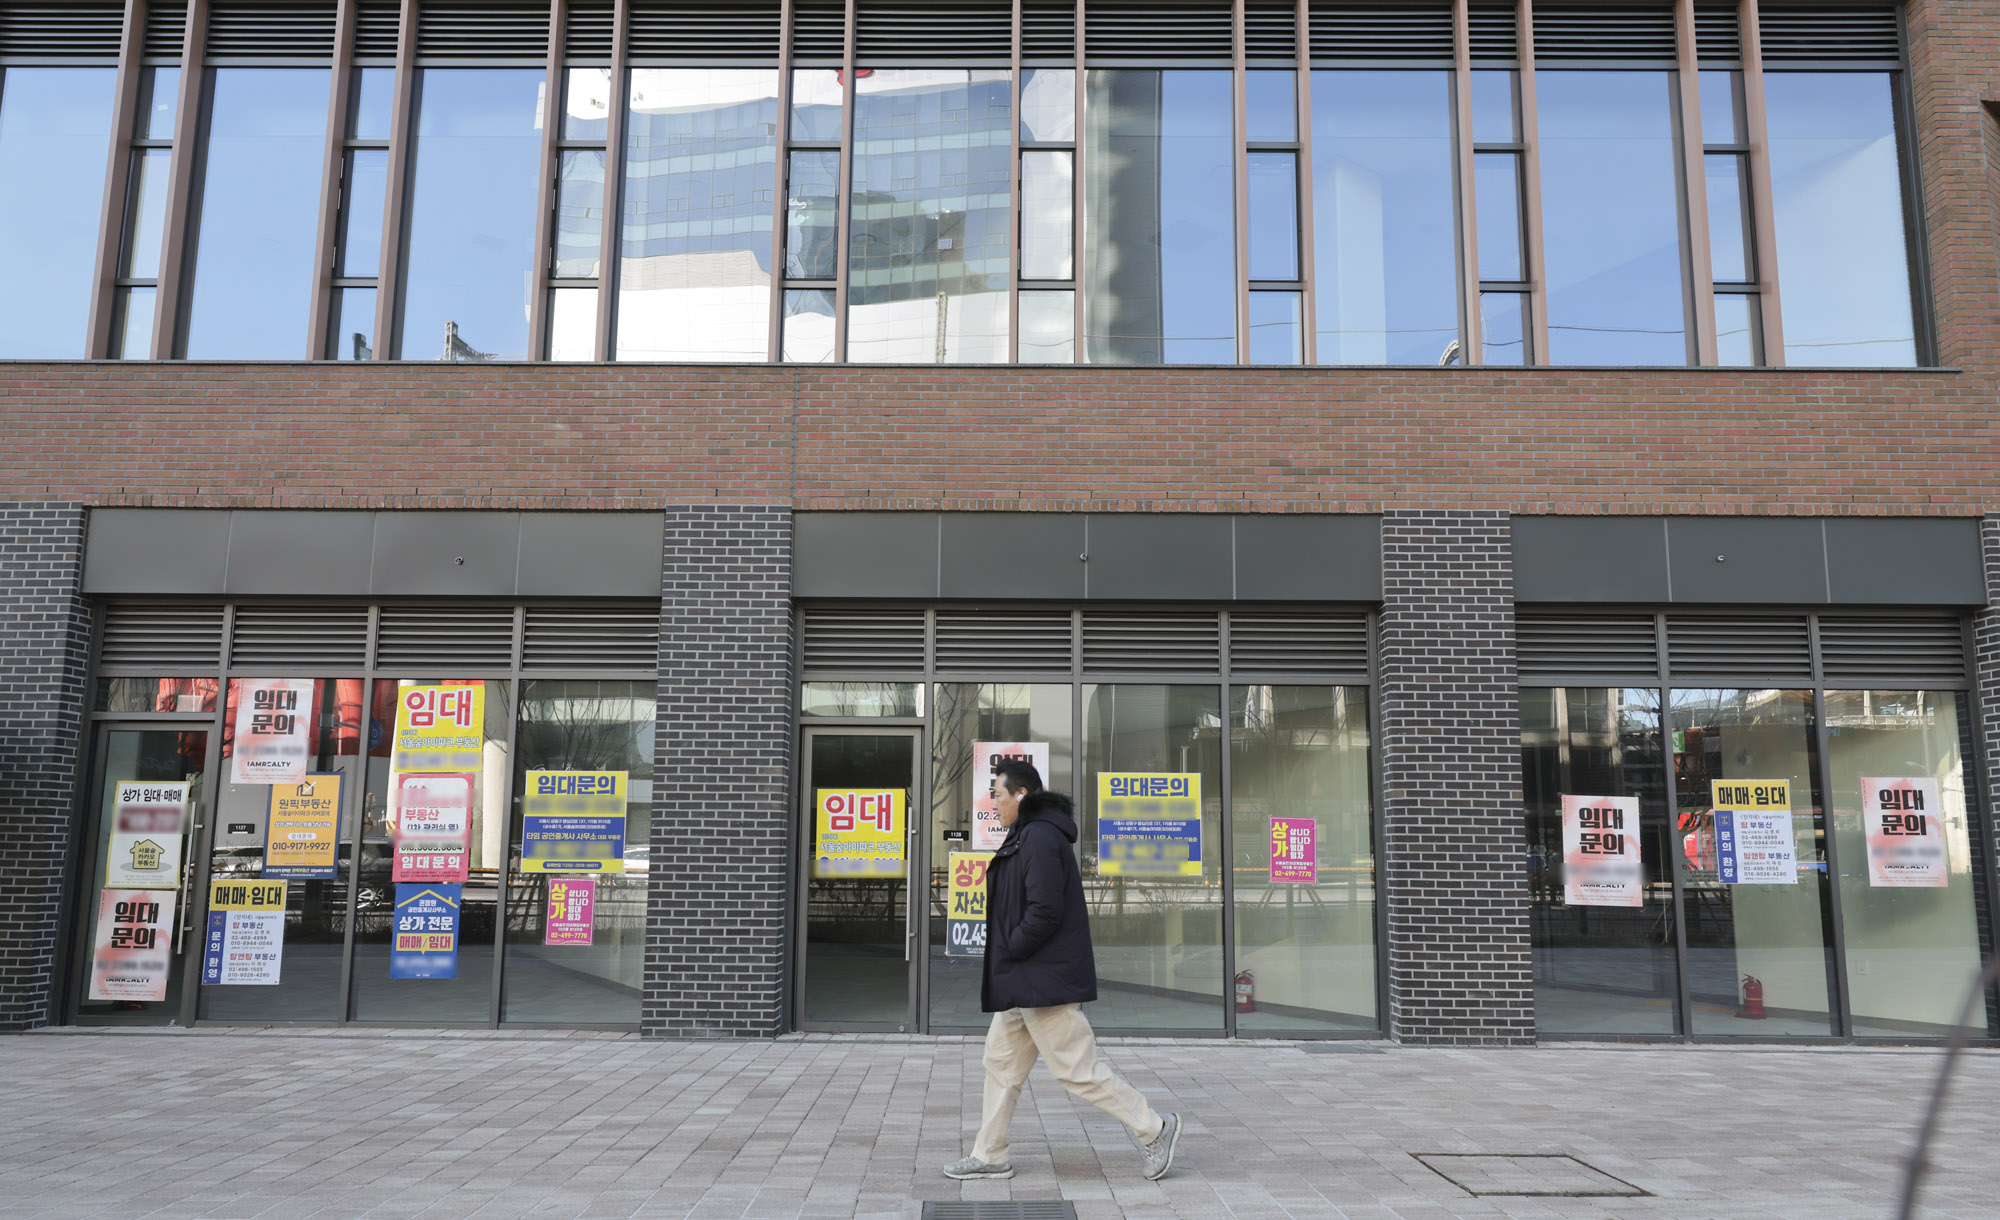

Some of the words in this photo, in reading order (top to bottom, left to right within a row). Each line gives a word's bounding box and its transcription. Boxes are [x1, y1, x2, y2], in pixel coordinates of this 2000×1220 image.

[254, 690, 297, 710] 임대
[405, 689, 473, 727] 임대
[252, 714, 295, 735] 문의
[399, 736, 455, 749] 서울숲아이파크
[456, 736, 480, 749] 부동산
[538, 776, 616, 795] 임대문의
[1110, 778, 1189, 797] 임대문의
[123, 789, 140, 802] 상가
[280, 799, 332, 810] 원픽부동산
[1718, 787, 1786, 805] 매매·임대
[1879, 790, 1924, 810] 임대
[405, 809, 440, 821] 부동산
[825, 793, 892, 831] 임대
[1579, 808, 1624, 829] 임대
[1882, 815, 1927, 836] 문의
[526, 832, 540, 840] 타임
[1272, 822, 1289, 858] 상가
[1579, 833, 1624, 855] 문의
[272, 842, 331, 850] 010-9171-9927
[820, 841, 876, 853] 서울숲아이파크
[877, 841, 902, 853] 부동산
[215, 887, 282, 905] 매매·임대
[550, 884, 568, 920] 상가
[115, 902, 159, 923] 임대
[399, 916, 425, 931] 상가
[428, 916, 454, 931] 전문
[111, 928, 156, 949] 문의
[255, 953, 277, 961] 부동산
